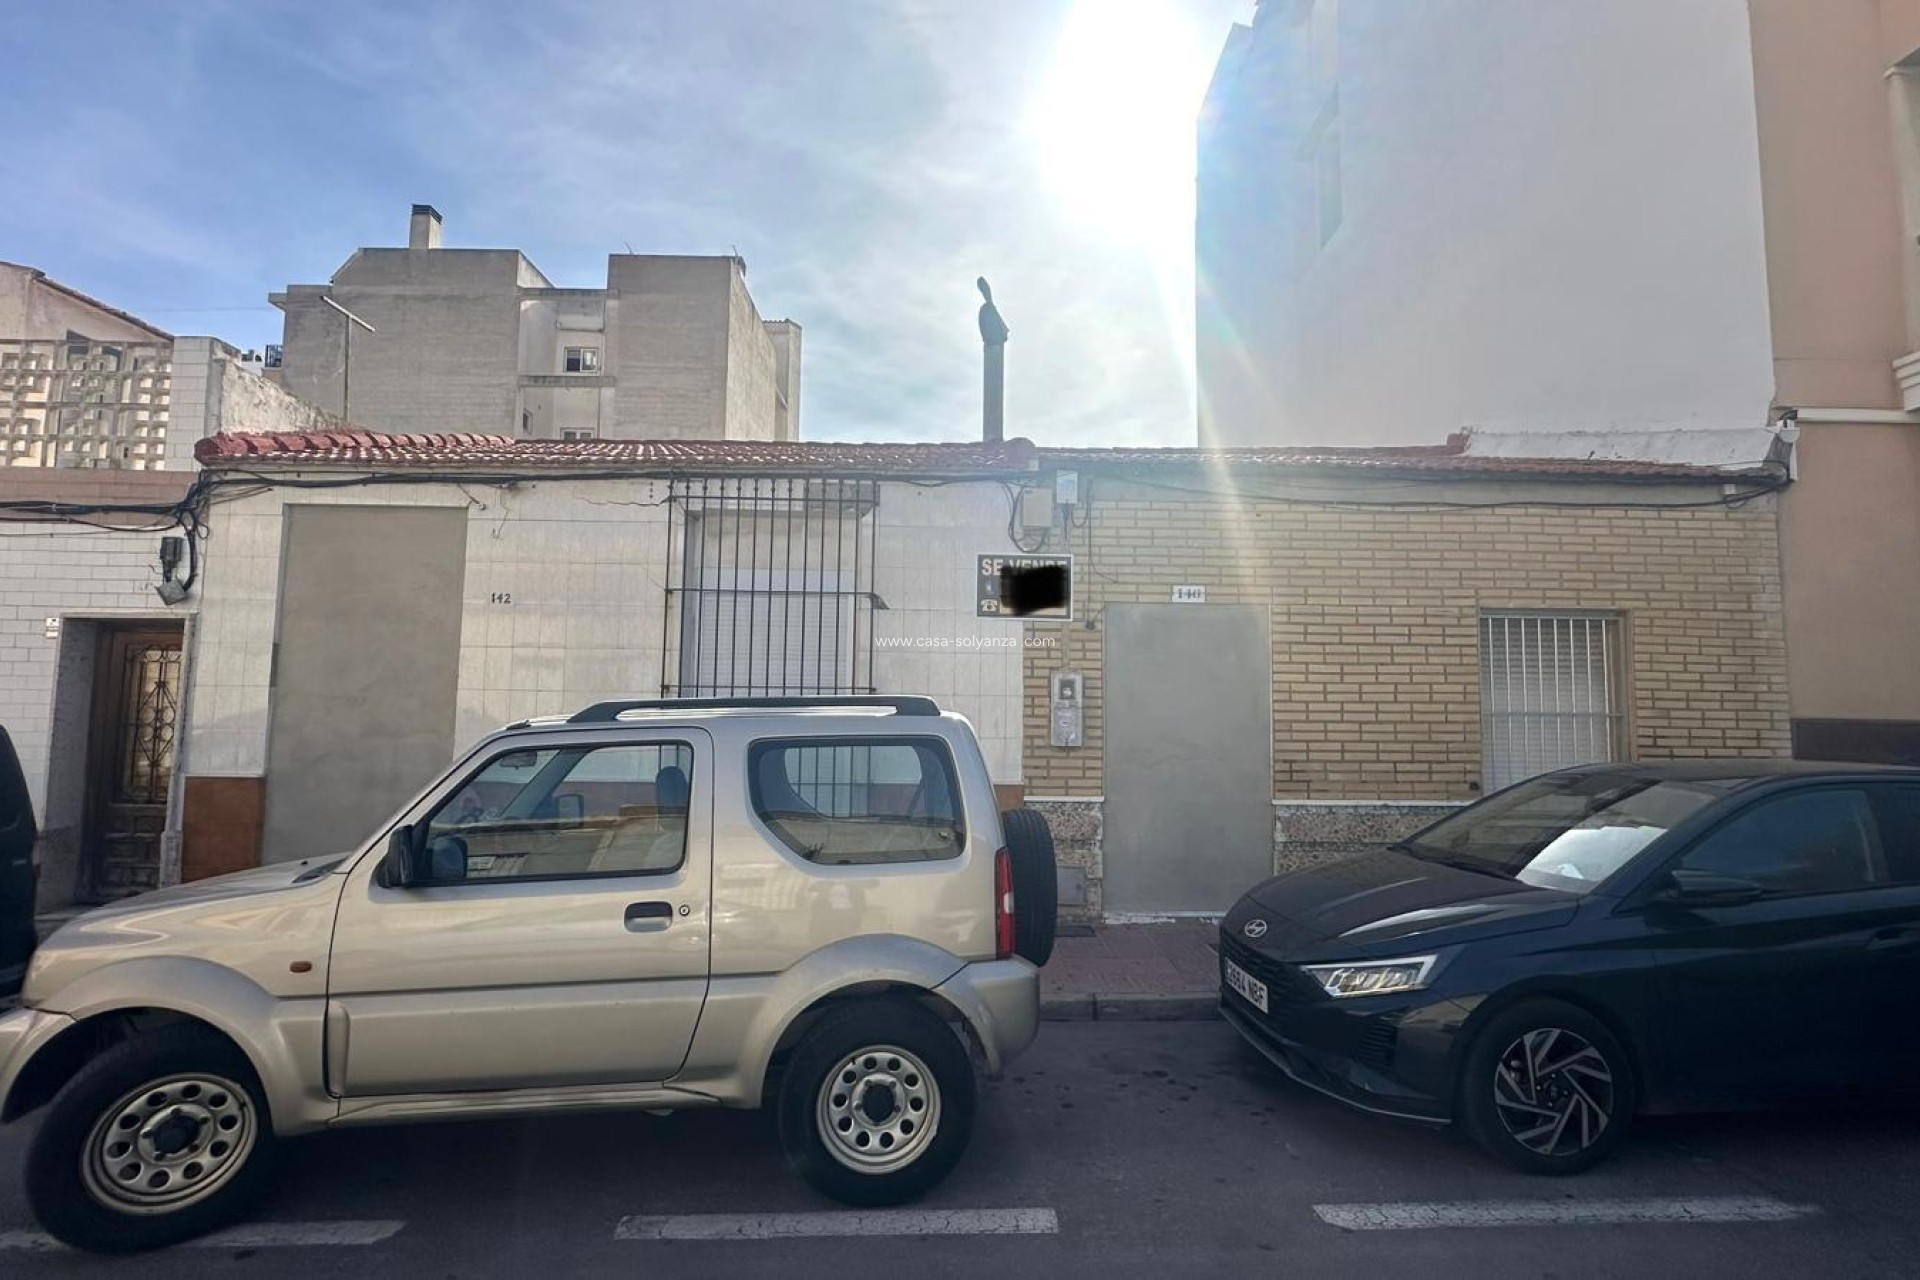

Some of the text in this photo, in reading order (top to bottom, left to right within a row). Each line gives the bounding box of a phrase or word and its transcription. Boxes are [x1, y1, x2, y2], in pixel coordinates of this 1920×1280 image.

[982, 559, 1003, 576] SE
[492, 592, 511, 604] 142
[1177, 587, 1201, 599] 140
